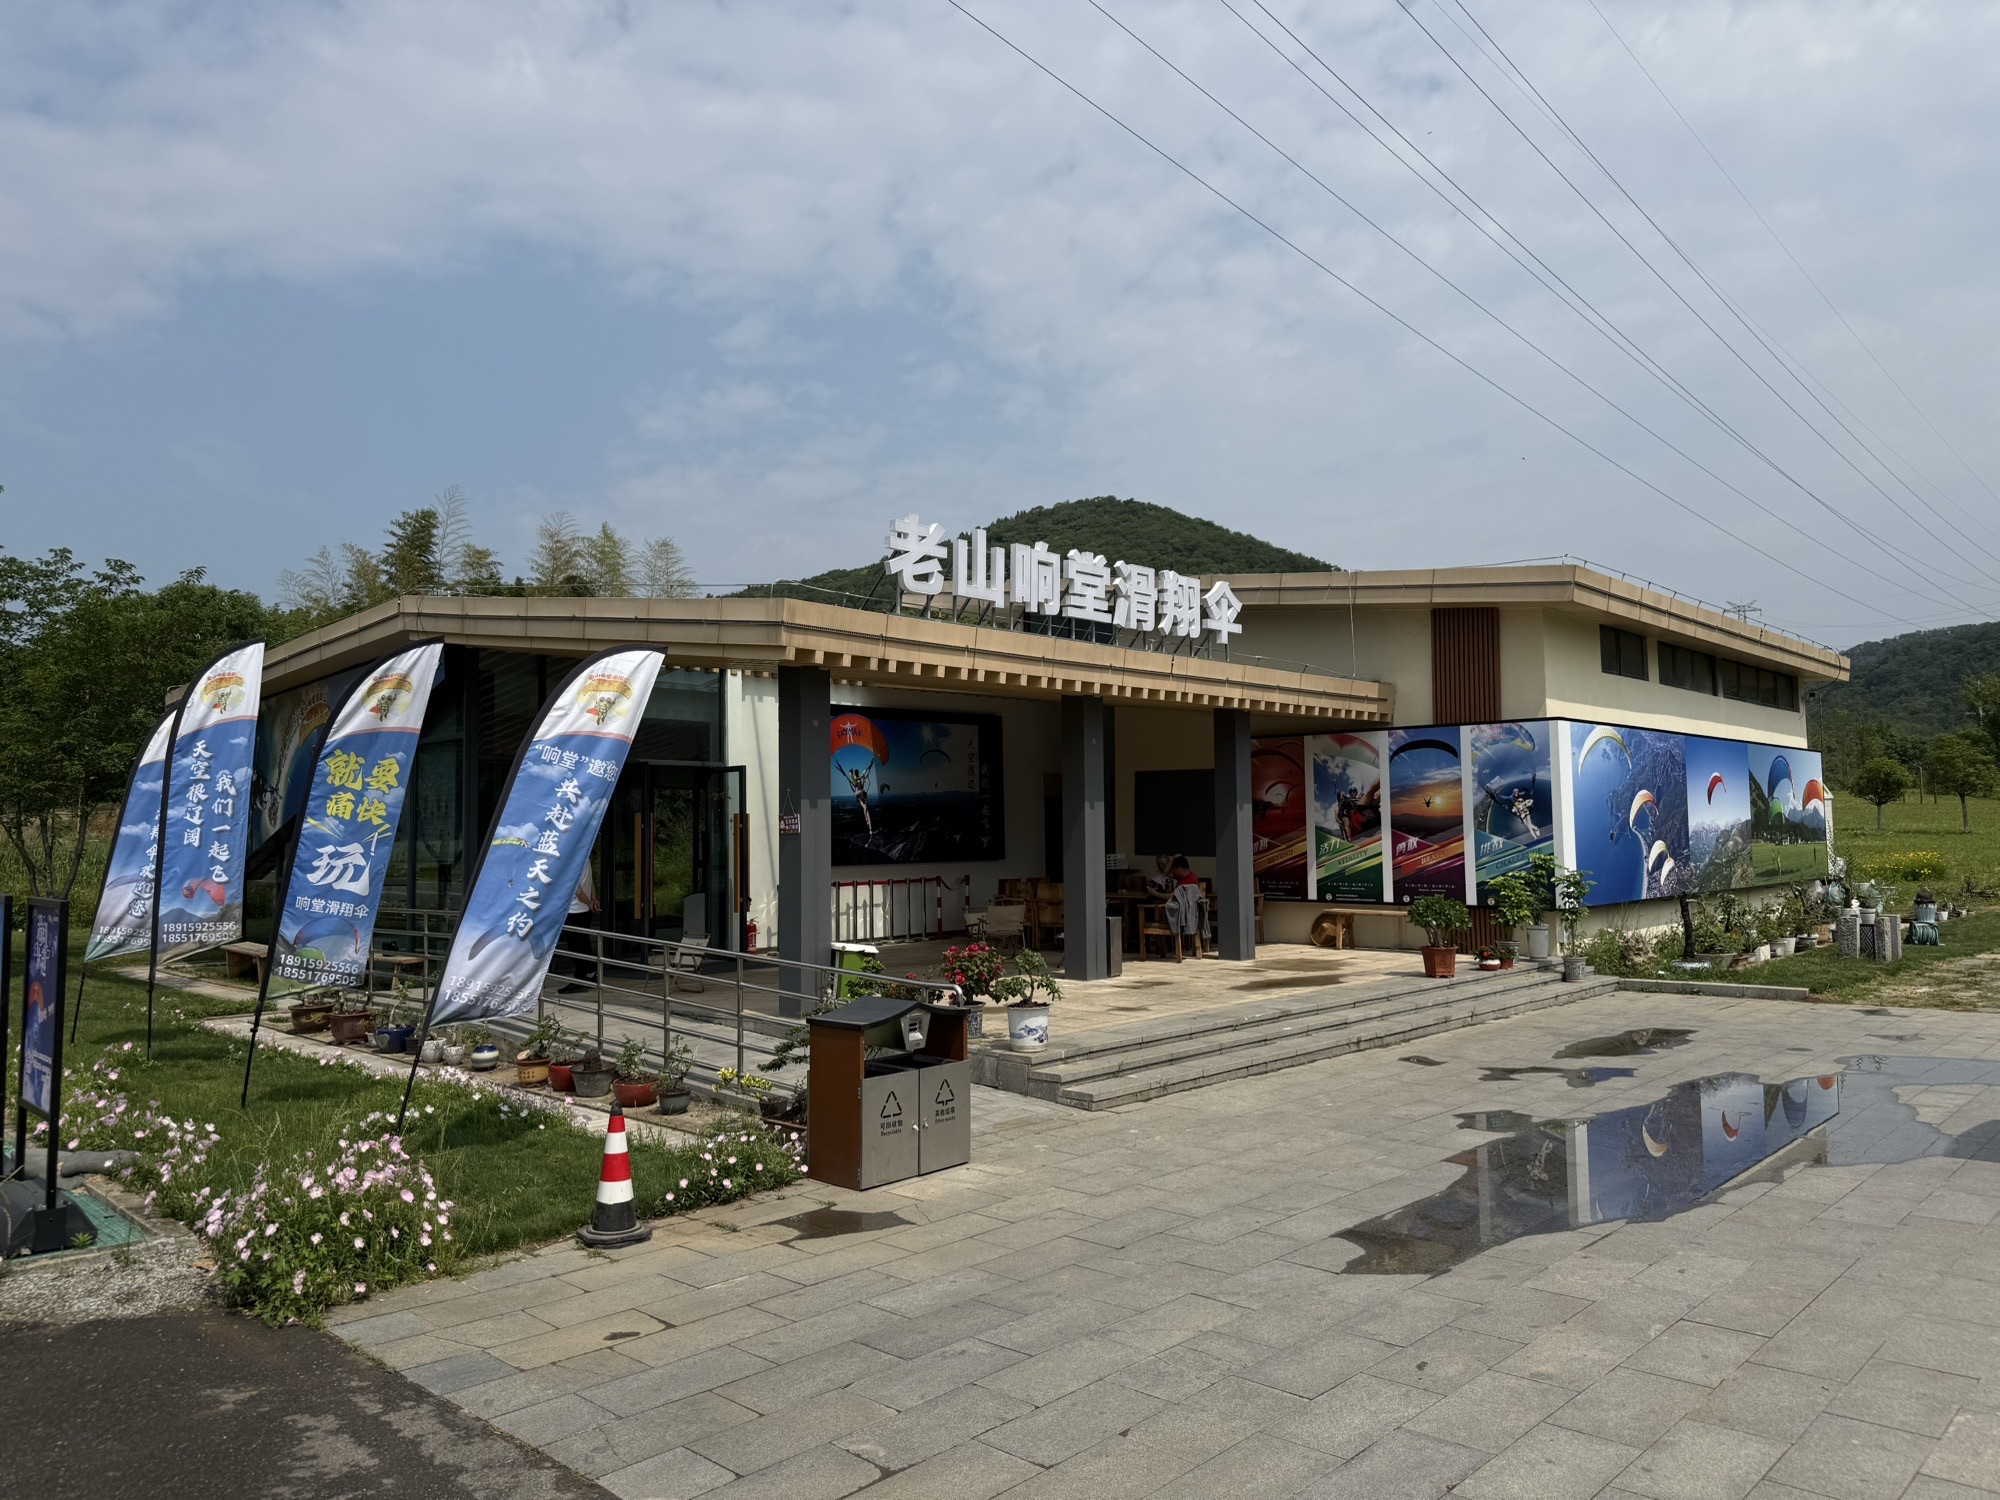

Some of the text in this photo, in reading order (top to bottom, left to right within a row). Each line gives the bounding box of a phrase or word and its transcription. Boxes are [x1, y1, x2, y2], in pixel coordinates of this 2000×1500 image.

[884, 512, 1243, 644] 老山响堂滑翔伞
[325, 748, 400, 795] 就要
[183, 740, 213, 848] 天空很辽阔
[326, 791, 387, 825] 痛快
[208, 773, 237, 883] 我们一起飞
[1319, 839, 1340, 856] 活力
[1395, 836, 1419, 856] 勇敢
[507, 777, 582, 939] 共赴蓝天之约
[1337, 848, 1369, 865] VITALITY
[295, 896, 369, 918] 响堂滑翔伞
[163, 922, 236, 932] 18915925556
[162, 933, 236, 943] 18551769505
[280, 954, 359, 974] 18915925556
[278, 966, 357, 986] 18551769505
[880, 1120, 904, 1131] 可回收物
